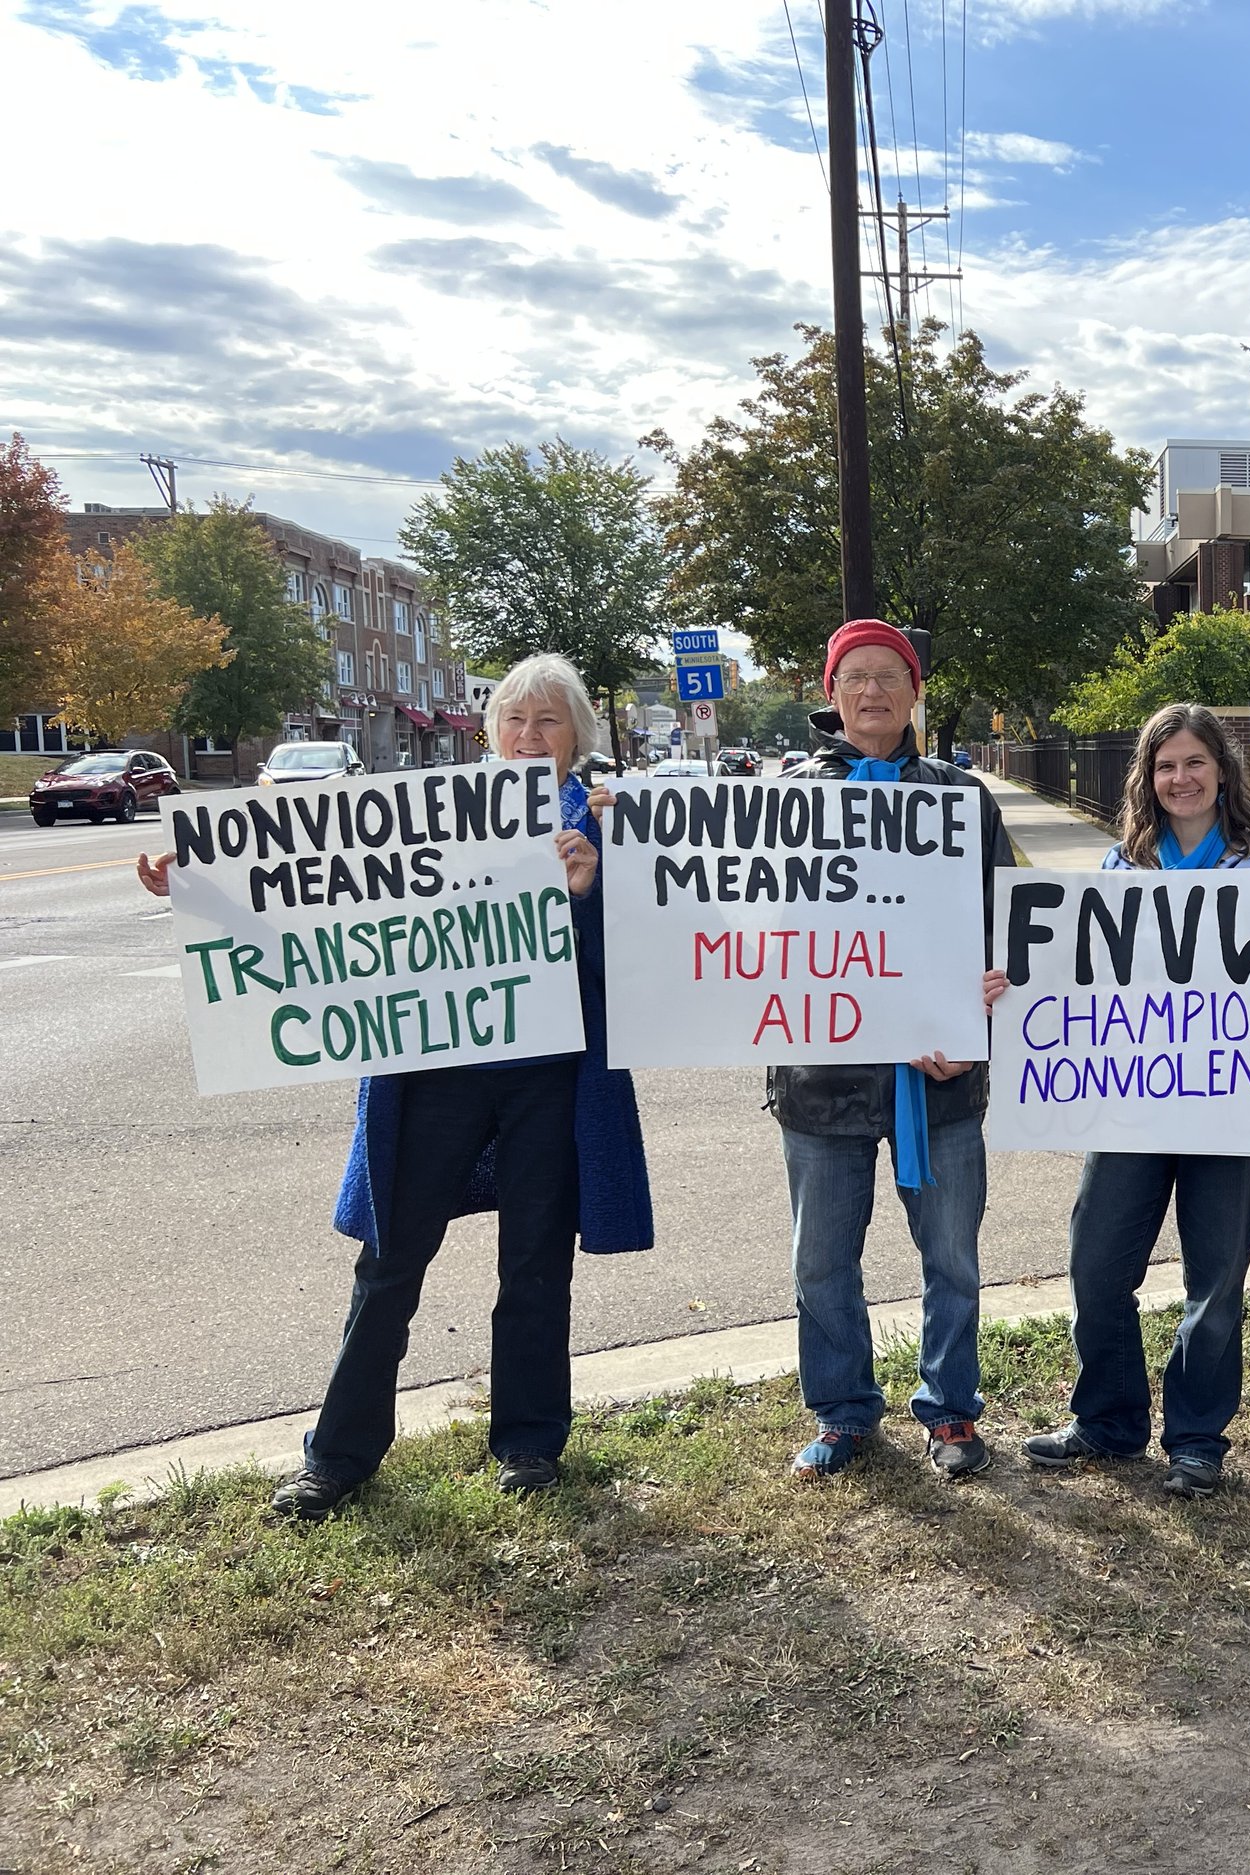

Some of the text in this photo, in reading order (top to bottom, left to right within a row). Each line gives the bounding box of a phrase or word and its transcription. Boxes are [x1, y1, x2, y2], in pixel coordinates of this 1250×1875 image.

[675, 634, 717, 650] SOUTH
[684, 655, 720, 664] MINNESOTA
[687, 671, 713, 695] 51
[173, 767, 552, 866] NONVIOLENCE
[613, 785, 967, 858] NONVIOLENCE
[250, 849, 492, 912] MEANS...
[656, 854, 908, 906] MEANS...
[187, 890, 571, 1001] TRANSFORMING
[695, 931, 900, 979] MUTUAL
[272, 976, 528, 1064] CONFLICT
[754, 994, 861, 1043] AID
